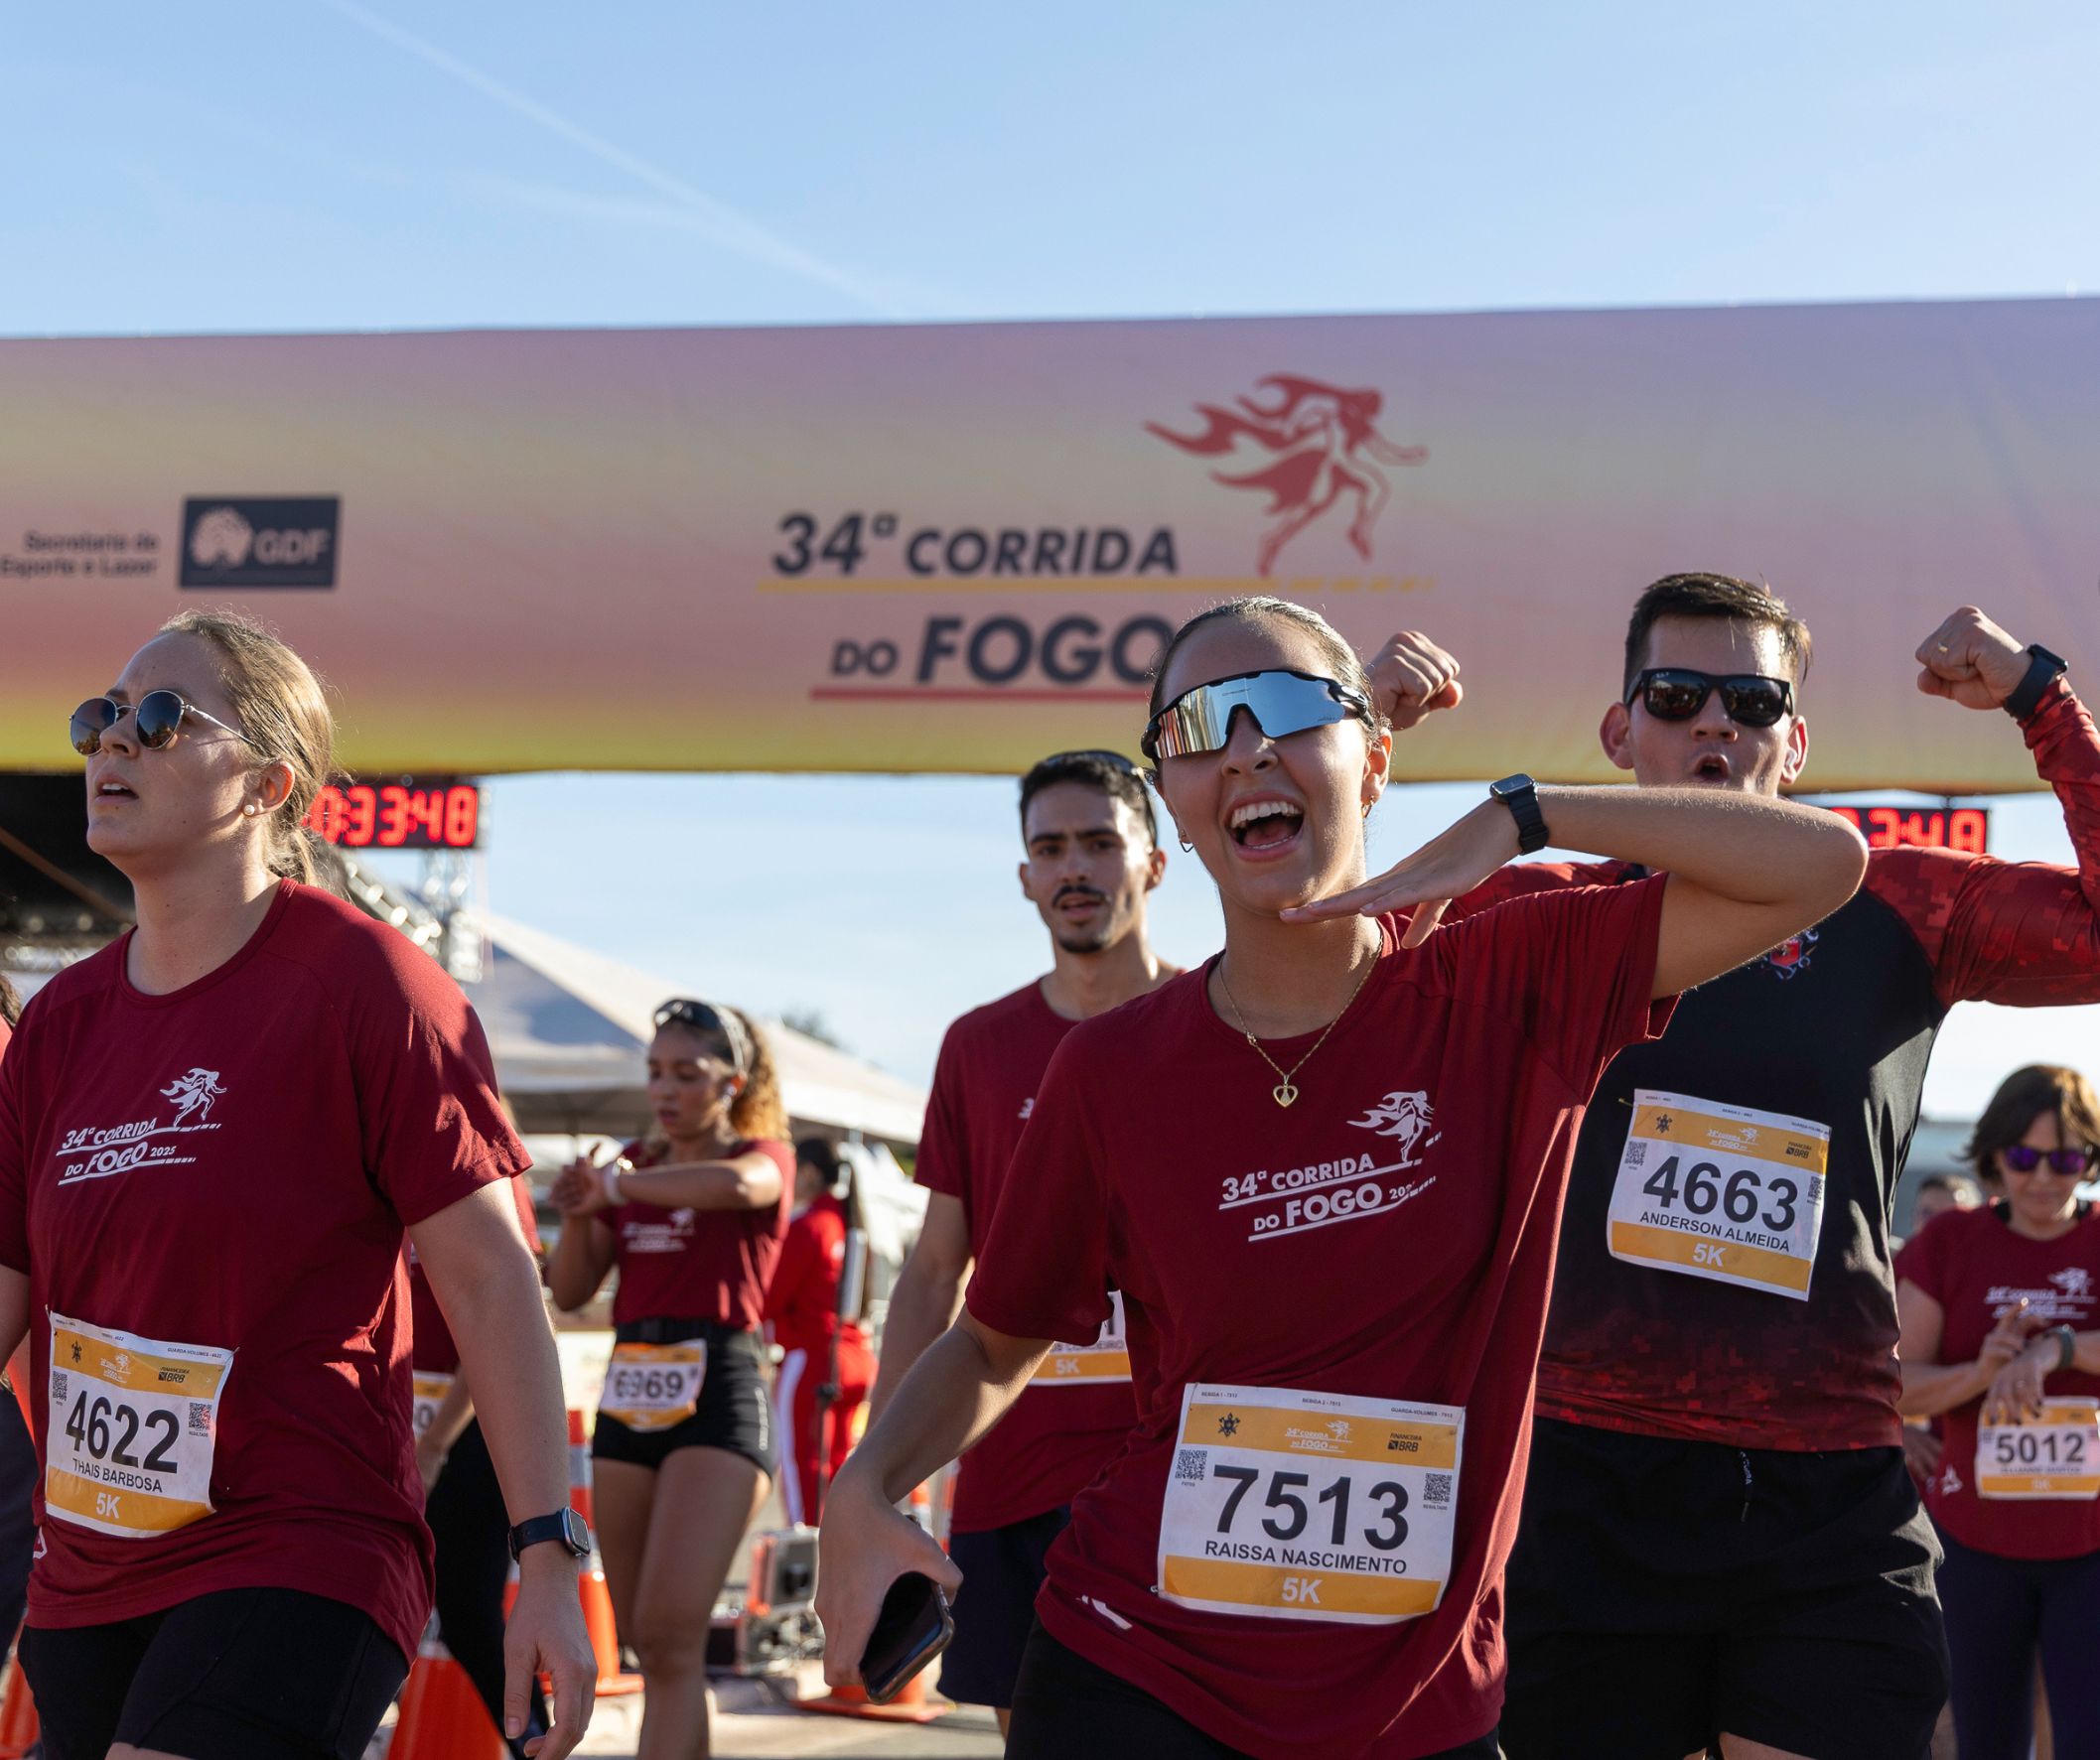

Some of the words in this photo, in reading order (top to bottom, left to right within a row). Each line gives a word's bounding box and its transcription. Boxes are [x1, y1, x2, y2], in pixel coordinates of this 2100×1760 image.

[255, 527, 331, 565] GDF
[772, 512, 899, 577] 34ª
[907, 528, 1179, 576] CORRIDA
[831, 640, 899, 677] DO
[915, 613, 1177, 685] FOGO
[93, 1118, 158, 1145] CORRIDA
[65, 1163, 83, 1176] DO
[84, 1142, 148, 1174] FOGO
[150, 1146, 177, 1157] 2025
[1794, 1149, 1809, 1158] BRB
[1222, 1169, 1267, 1201] 34ª
[1271, 1152, 1374, 1190] CORRIDA
[1642, 1155, 1798, 1232] 4663
[1253, 1214, 1280, 1231] DO
[1286, 1182, 1382, 1227] FOGO
[1639, 1211, 1722, 1237] ANDERSON
[1725, 1228, 1790, 1253] ALMEIDA
[1692, 1243, 1727, 1268] 5K
[167, 1373, 185, 1383] BRB
[1055, 1358, 1080, 1374] 5K
[66, 1390, 180, 1474] 4622
[1398, 1441, 1419, 1452] BRB
[1997, 1431, 2084, 1463] 5012
[72, 1457, 100, 1477] THAIS
[102, 1467, 163, 1493] BARBOSA
[96, 1492, 120, 1519] 5K
[1213, 1464, 1409, 1551] 7513
[1205, 1540, 1276, 1562] RAISSA
[1281, 1549, 1407, 1574] NASCIMENTO
[1281, 1577, 1323, 1604] 5K
